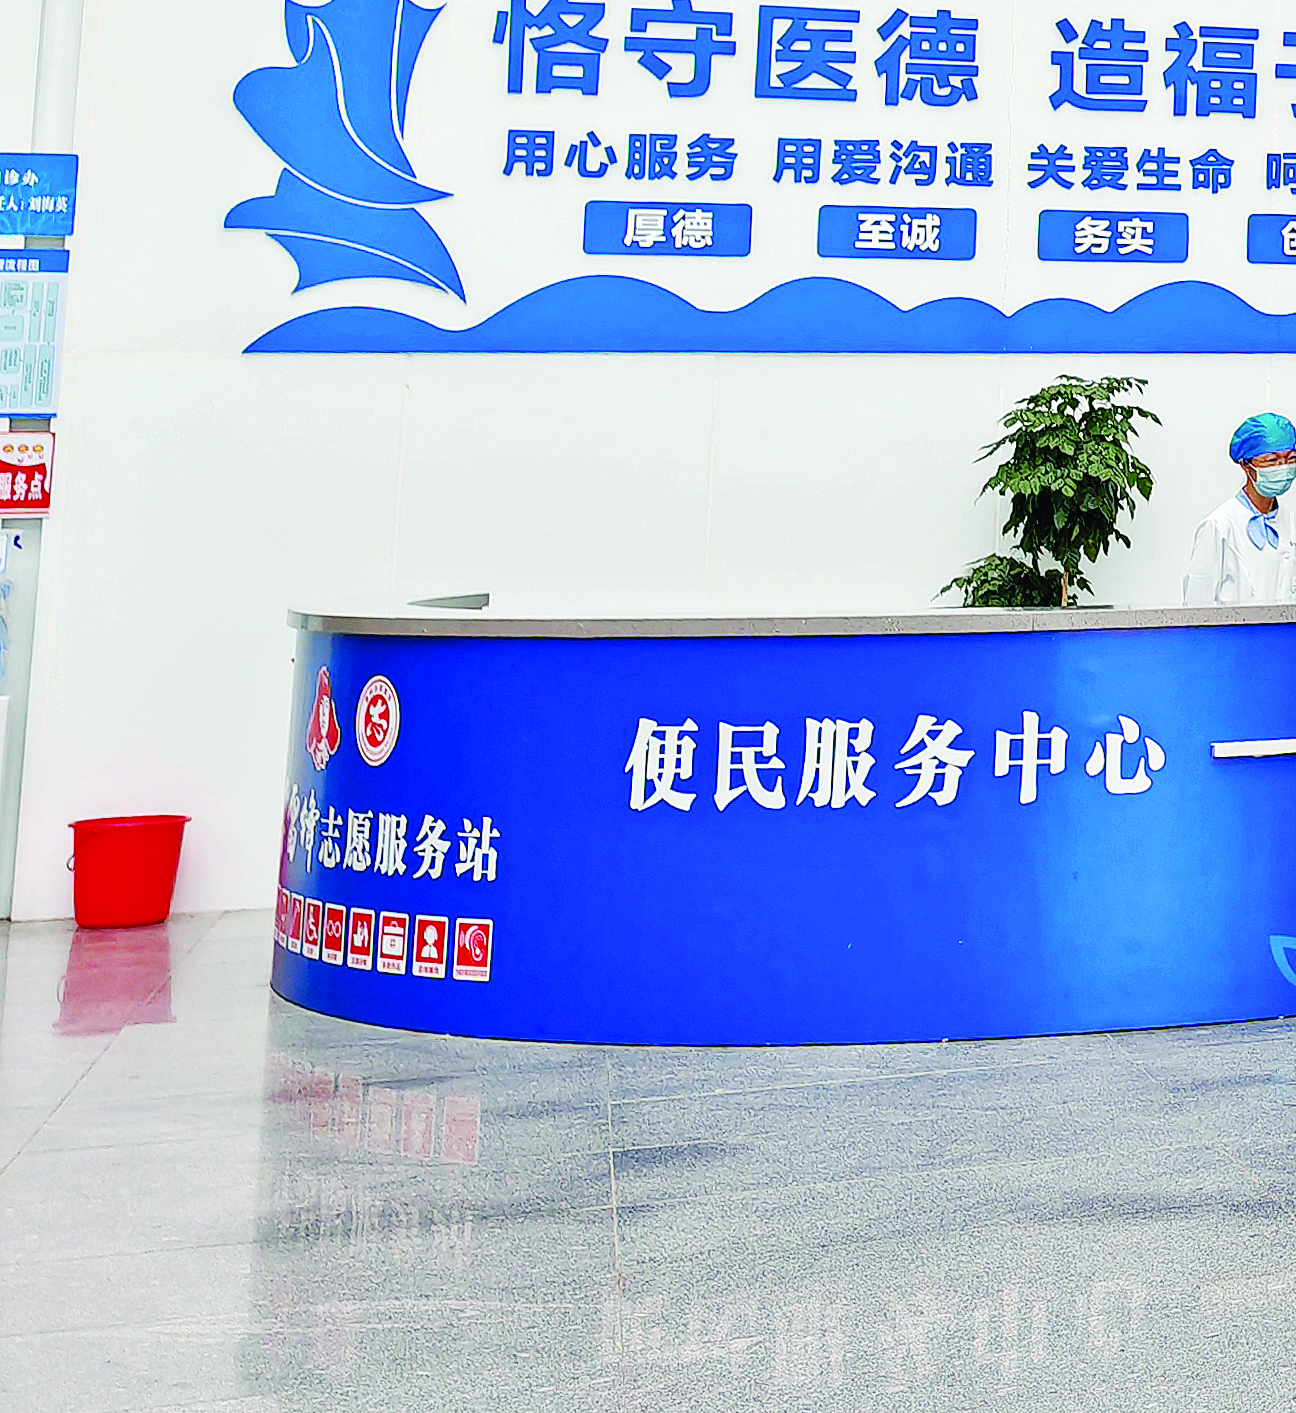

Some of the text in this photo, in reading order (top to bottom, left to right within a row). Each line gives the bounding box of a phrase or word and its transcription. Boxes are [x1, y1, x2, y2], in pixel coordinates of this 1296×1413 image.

[0, 168, 39, 187] 诊办
[503, 129, 738, 183] 用心服务
[773, 137, 994, 188] 用爱沟通
[1027, 144, 1235, 194] 关爱生命
[623, 208, 714, 250] 厚德
[854, 212, 941, 253] 至诚
[1073, 216, 1155, 257] 务实
[624, 710, 1166, 812] 便民服务中心
